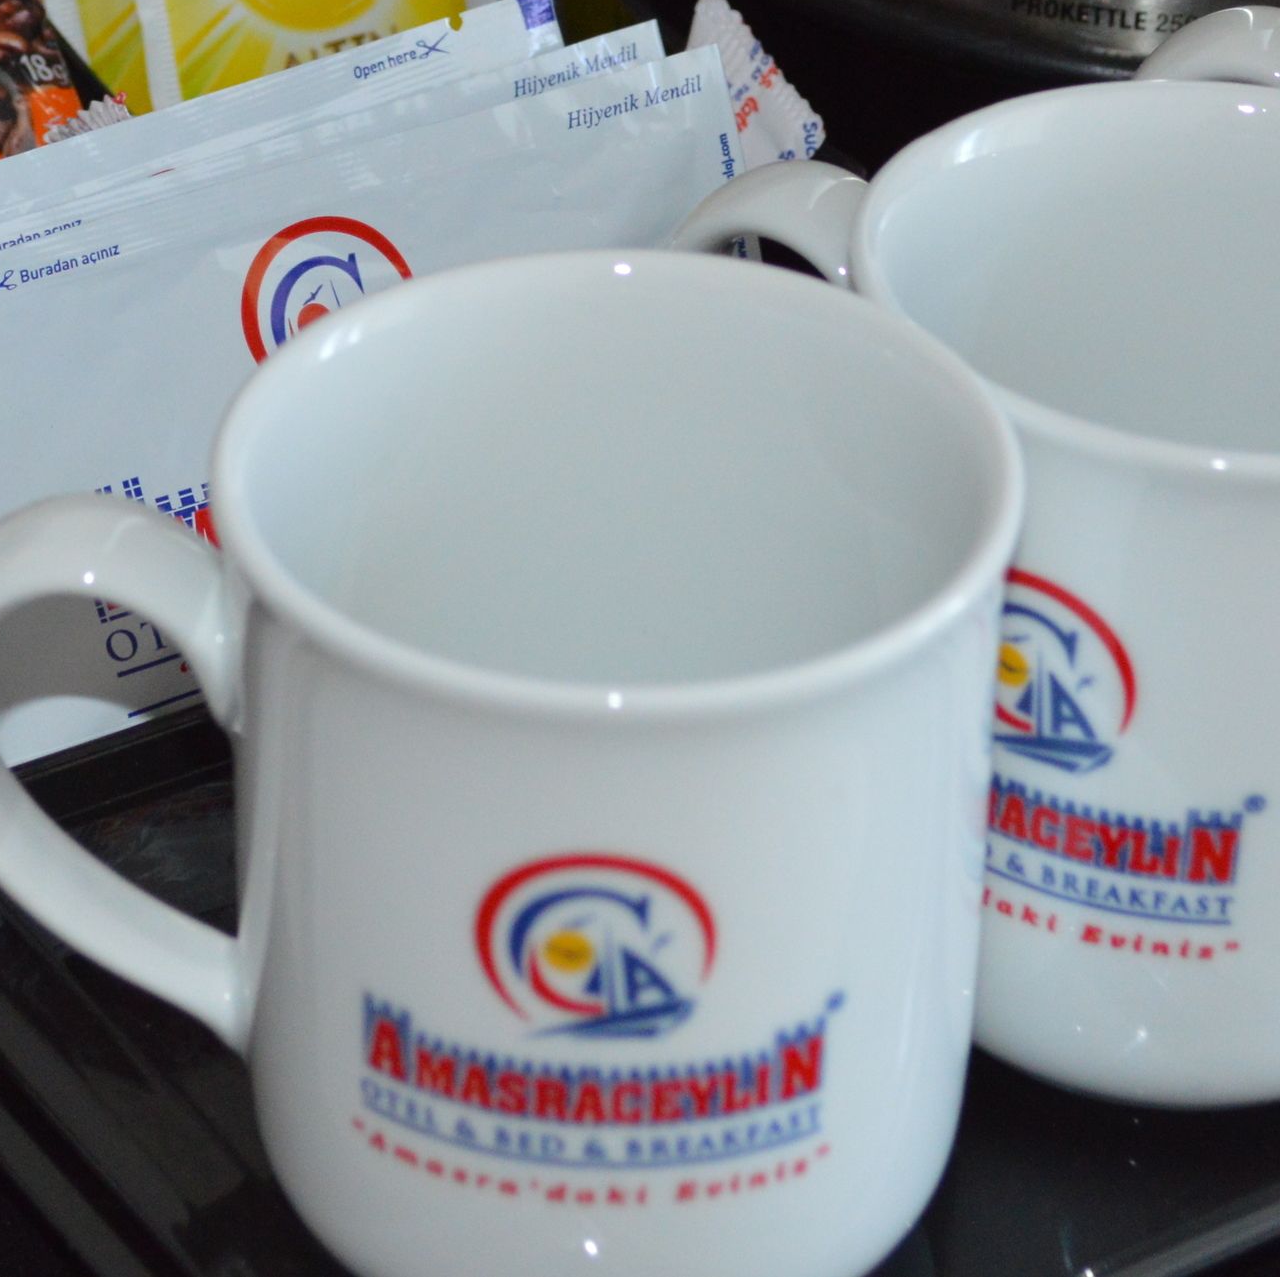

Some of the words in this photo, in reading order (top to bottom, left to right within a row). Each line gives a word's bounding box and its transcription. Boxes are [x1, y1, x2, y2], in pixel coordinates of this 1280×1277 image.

[353, 60, 387, 81] Open
[387, 48, 418, 69] here
[514, 63, 581, 98] Hijyenik
[585, 42, 638, 76] Mendil
[567, 94, 640, 130] Hijyenik
[645, 75, 703, 109] Mendil
[20, 258, 79, 284] Buradan
[81, 244, 120, 265] açınız
[1040, 864, 1235, 917] BREAKFAST
[491, 1123, 566, 1161] BED
[623, 1103, 823, 1161] BREAKFAST
